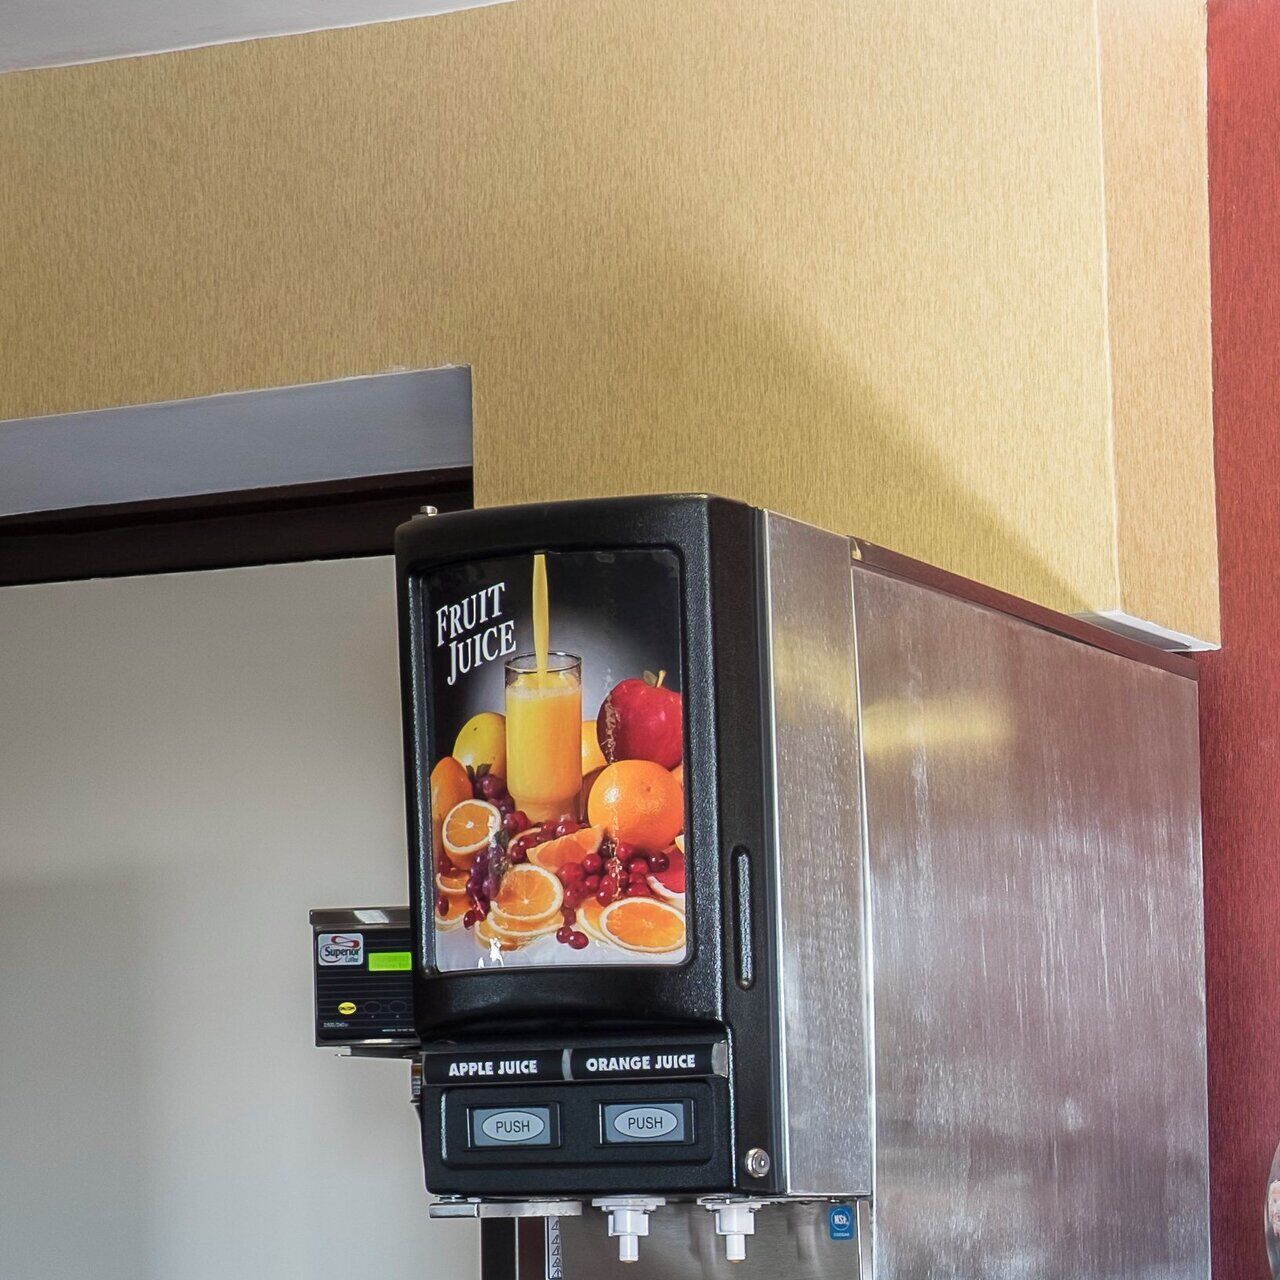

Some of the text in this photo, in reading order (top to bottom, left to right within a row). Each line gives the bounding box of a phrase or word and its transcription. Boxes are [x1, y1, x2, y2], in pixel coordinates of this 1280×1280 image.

[436, 582, 505, 647] FRUIT
[447, 620, 517, 685] JUICE
[325, 945, 360, 959] Superior
[448, 1060, 538, 1077] APPLE JUICE
[585, 1054, 696, 1071] ORANGE JUICE
[496, 1120, 531, 1133] PUSH
[628, 1117, 663, 1129] PUSH
